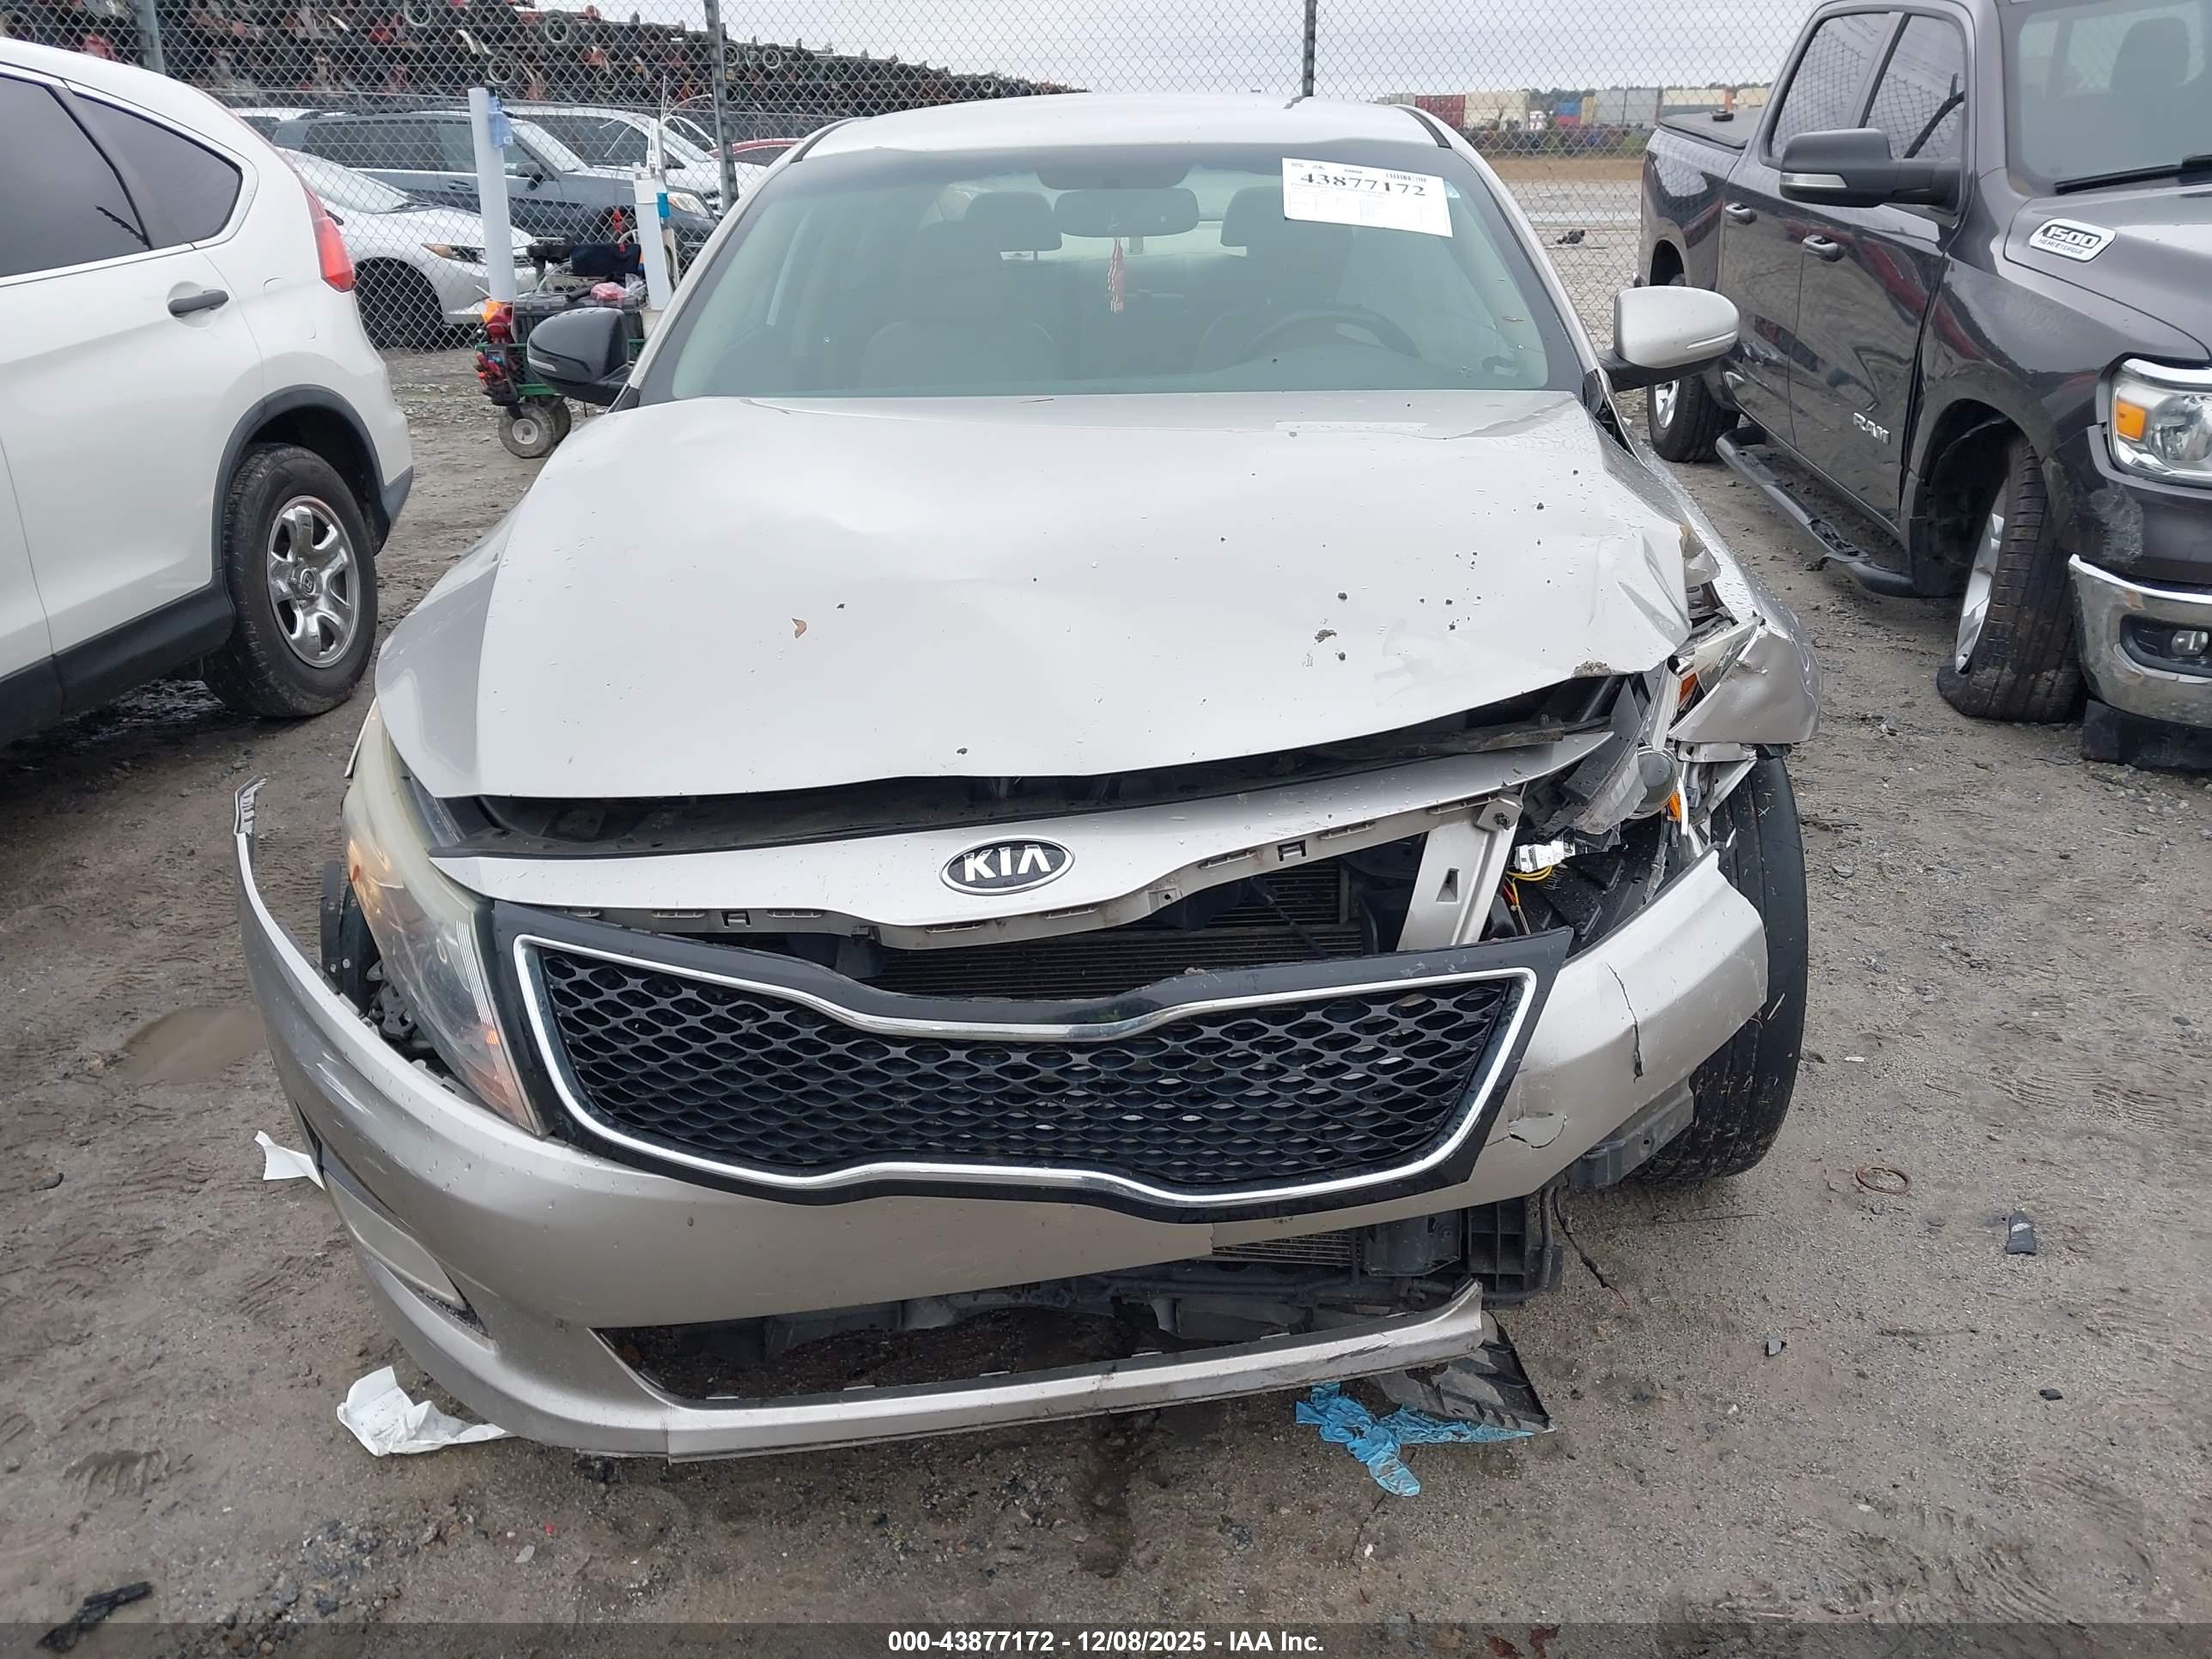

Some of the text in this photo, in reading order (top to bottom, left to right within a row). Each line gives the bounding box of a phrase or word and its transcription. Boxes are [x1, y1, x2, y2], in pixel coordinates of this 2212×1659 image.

[1300, 173, 1426, 197] 43877172
[2046, 226, 2100, 249] 1500
[1853, 412, 1890, 444] RAM
[963, 844, 1052, 882] KIA
